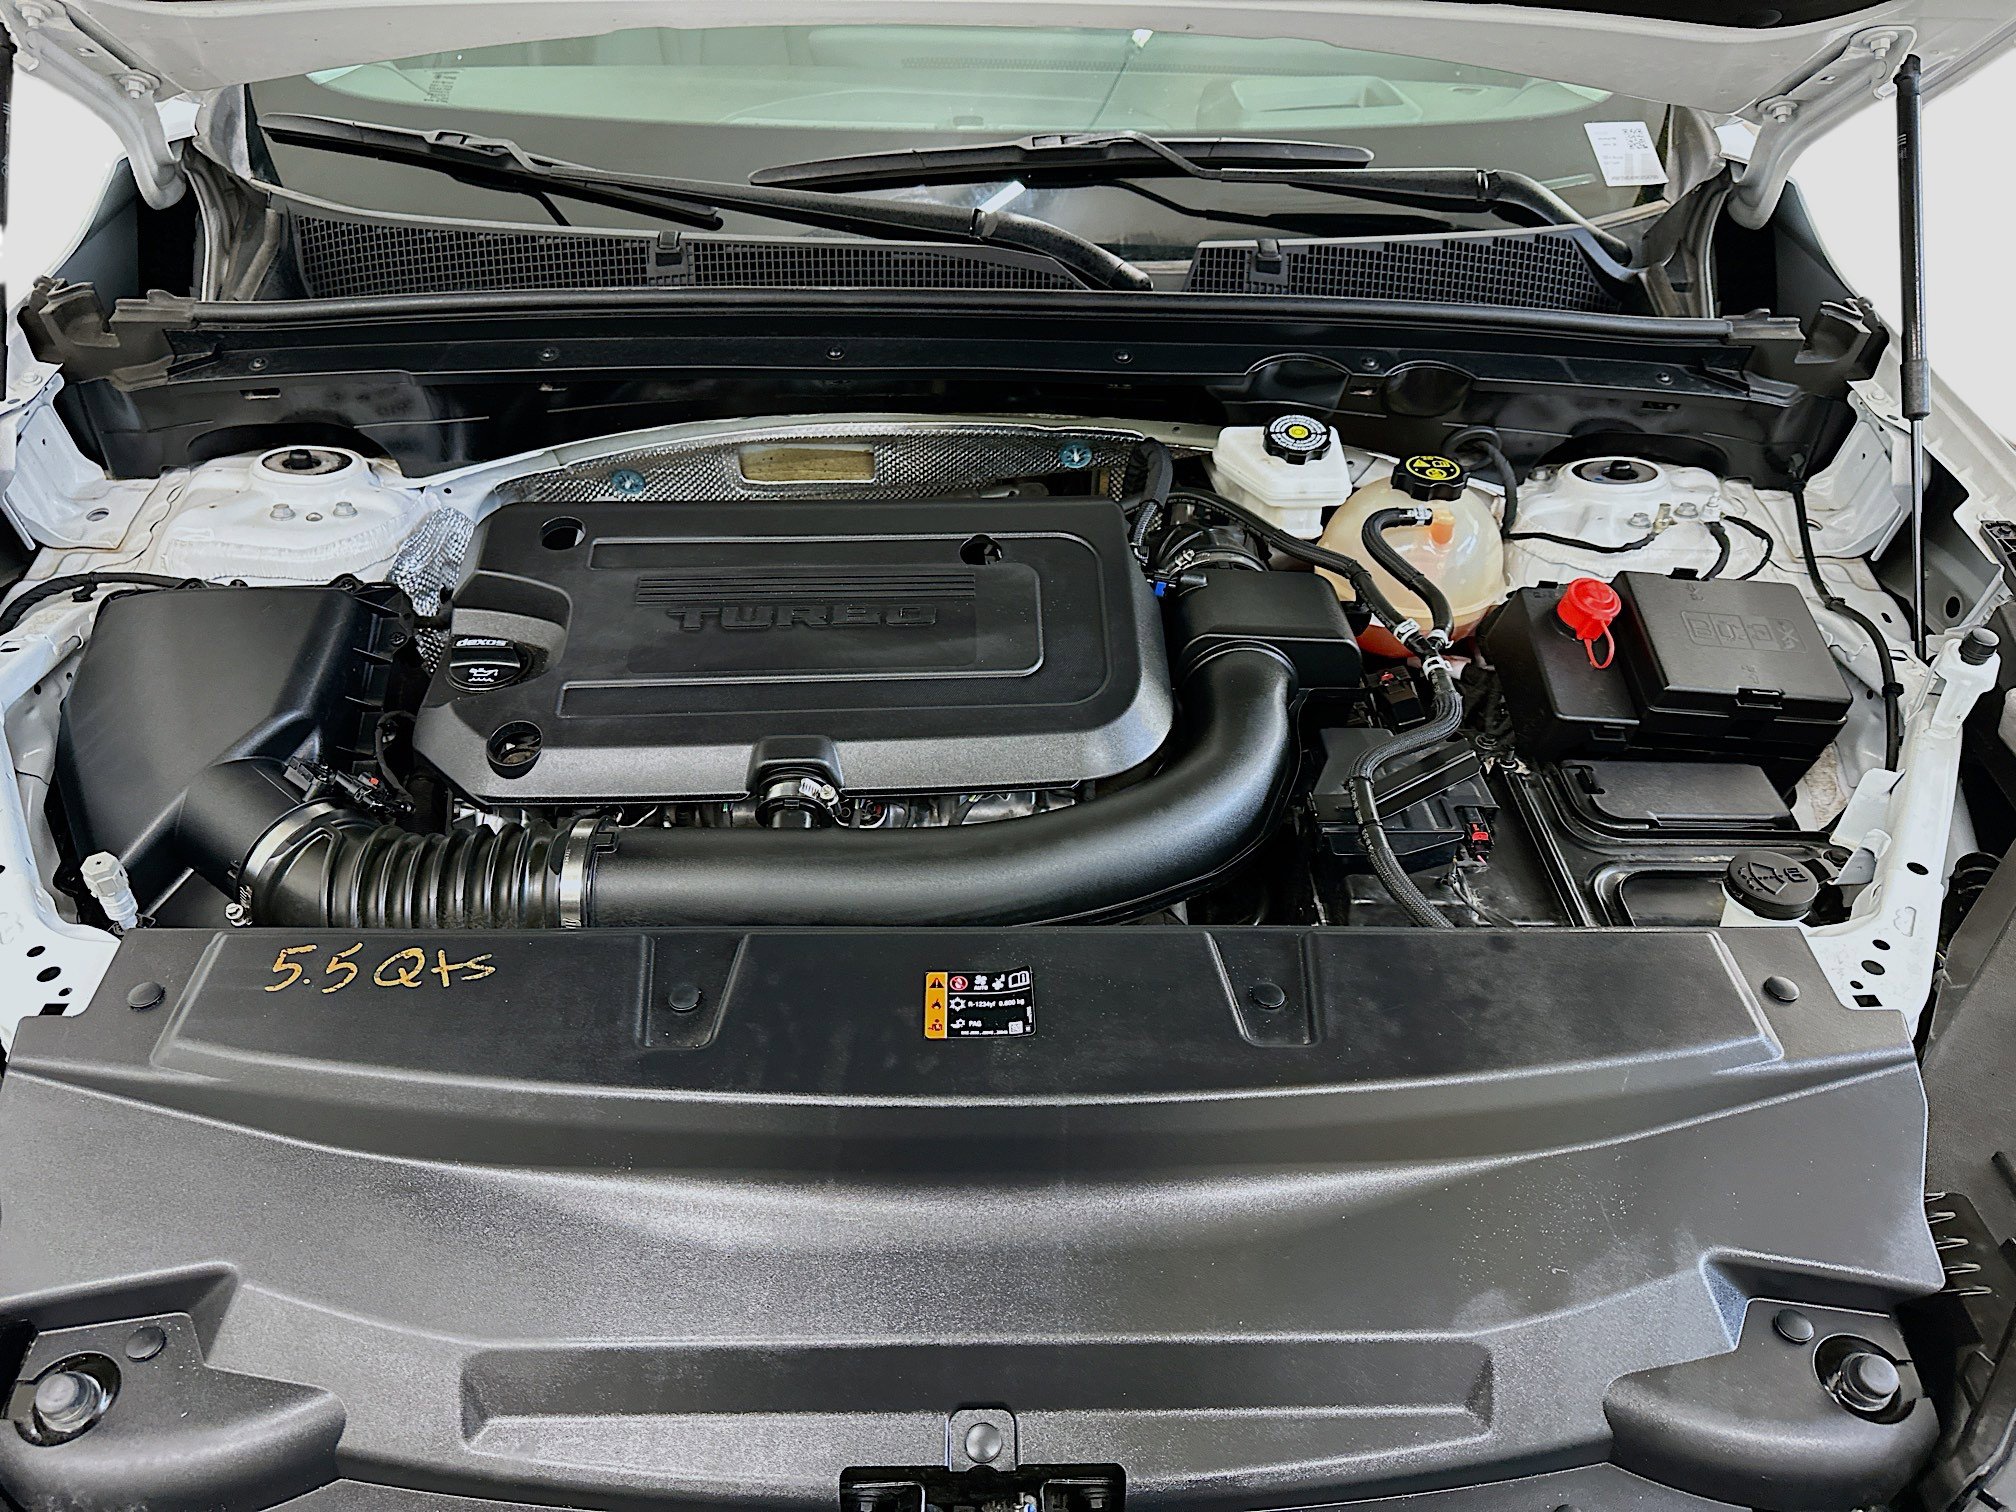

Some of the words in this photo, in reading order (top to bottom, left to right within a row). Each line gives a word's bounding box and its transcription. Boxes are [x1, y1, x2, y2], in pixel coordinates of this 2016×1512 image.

[666, 604, 936, 632] TURBO
[455, 638, 509, 647] dexos
[264, 942, 364, 994] 5.5
